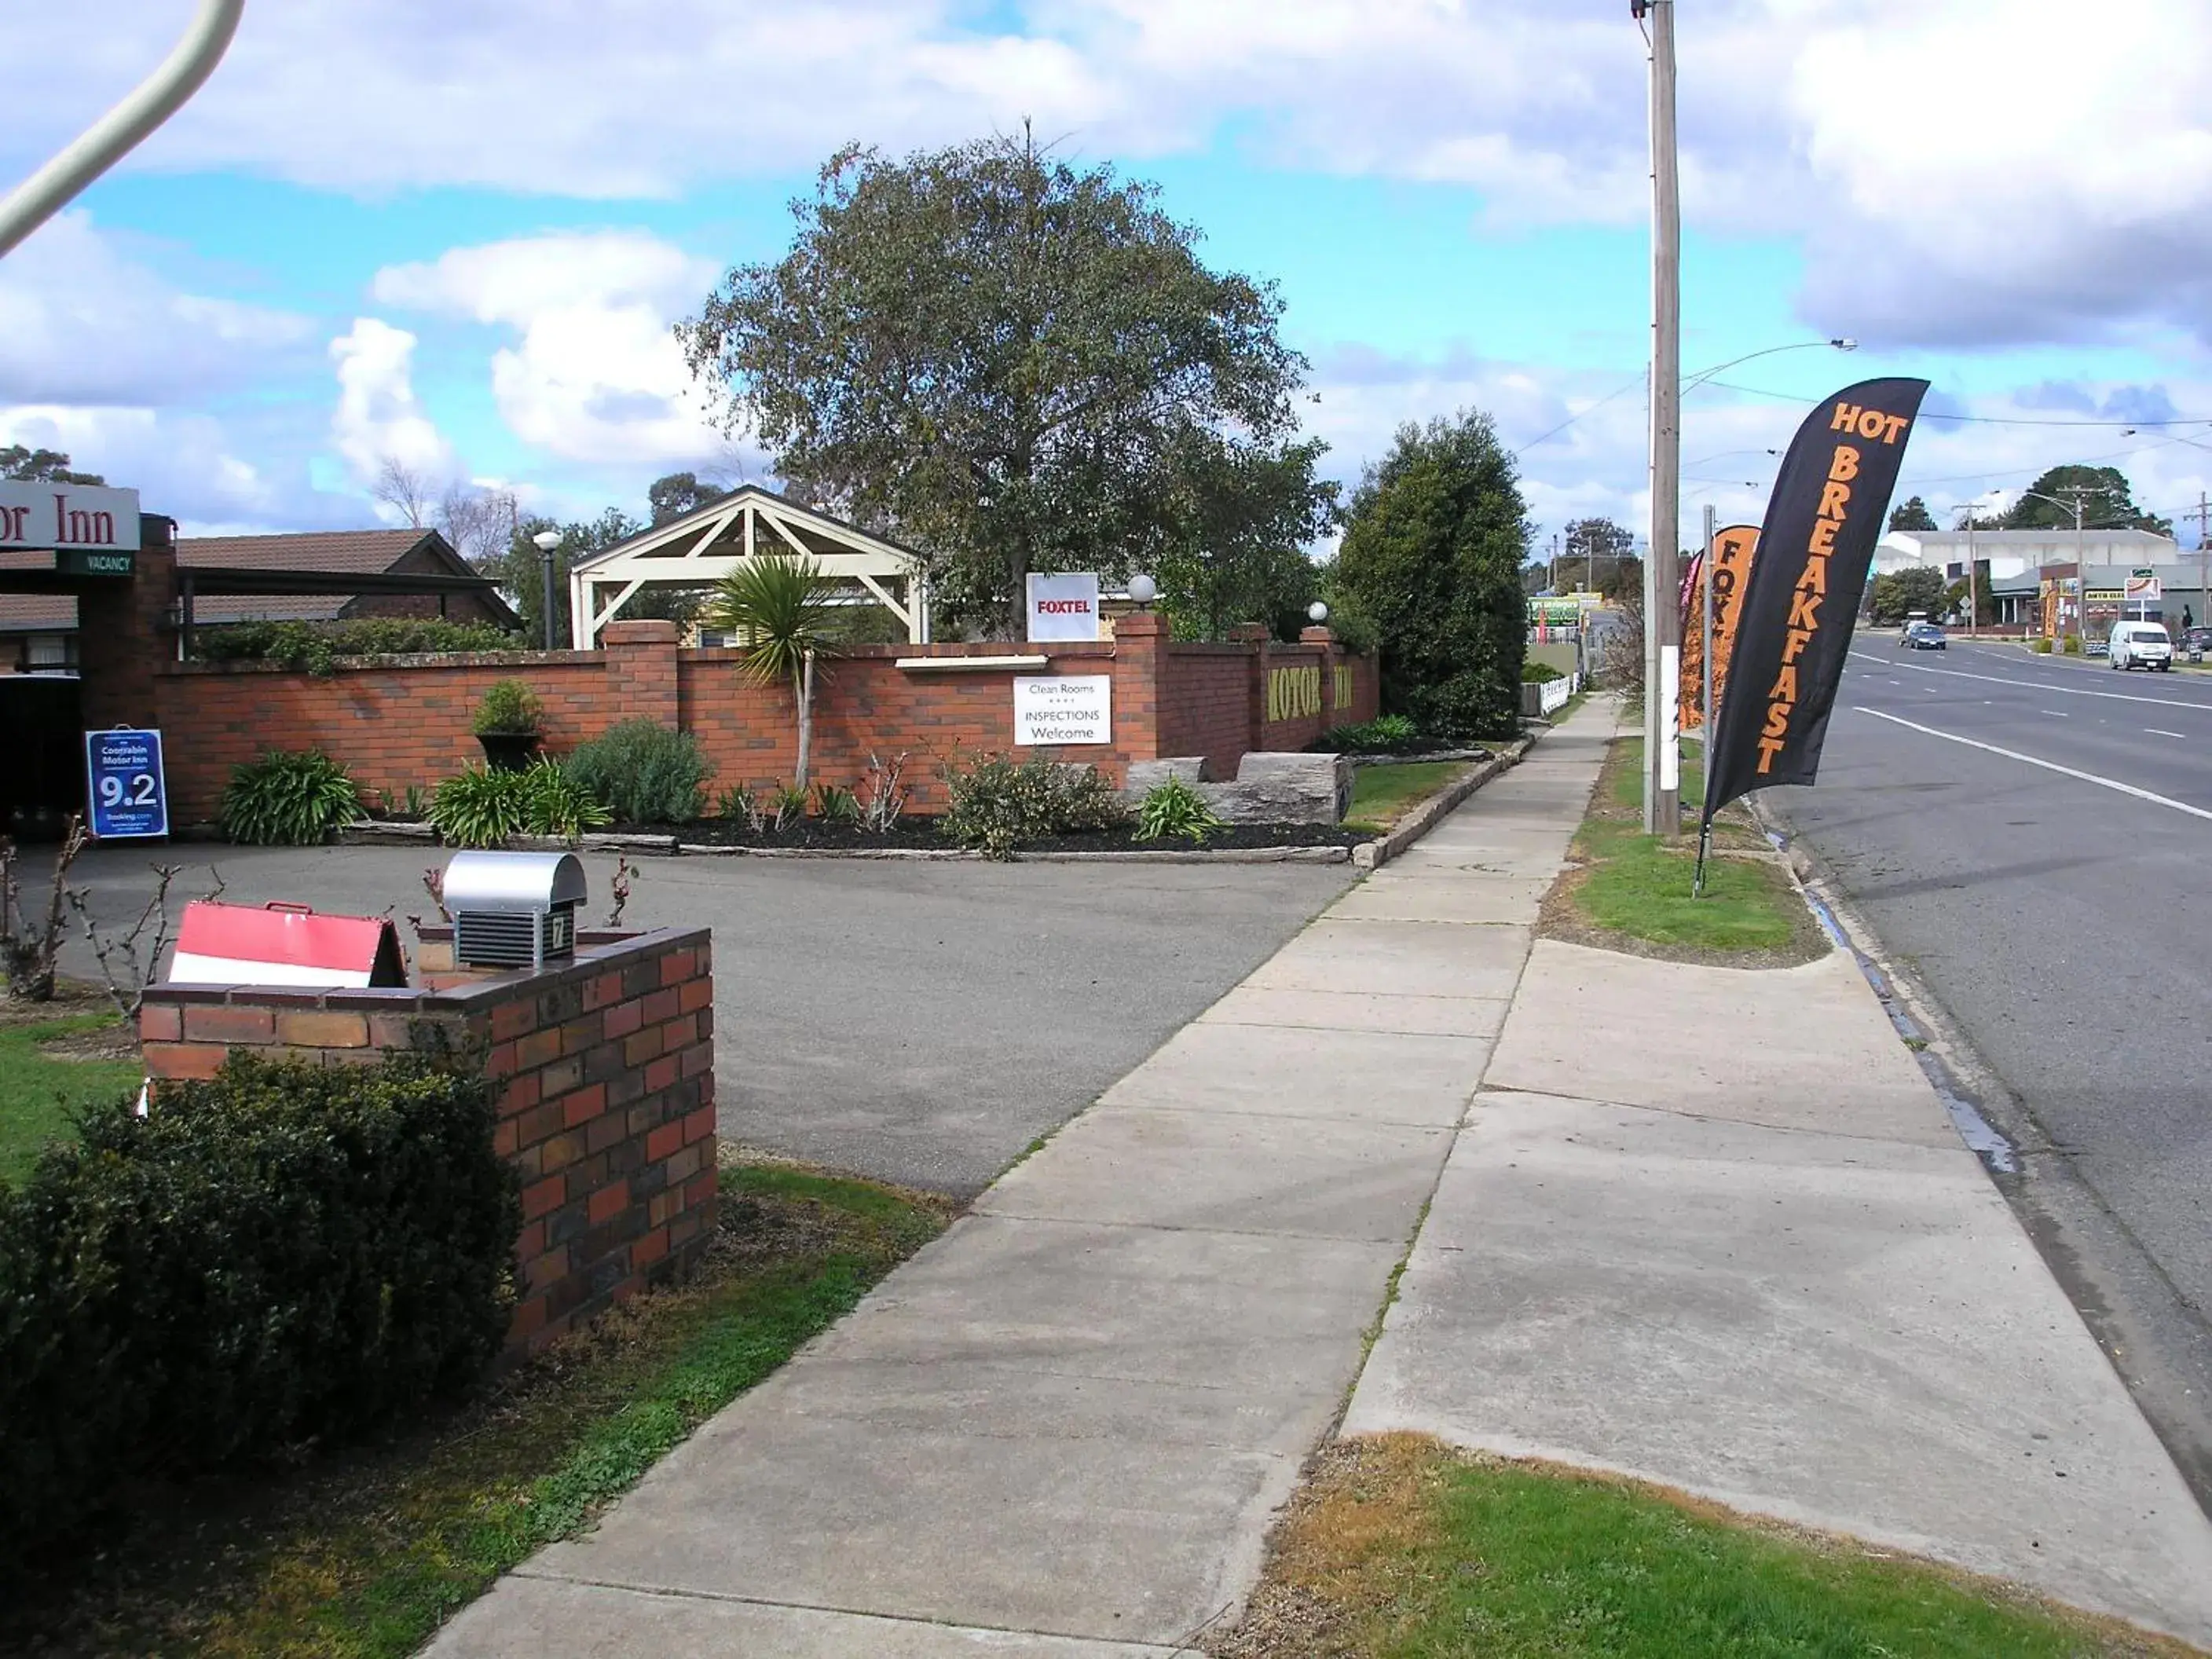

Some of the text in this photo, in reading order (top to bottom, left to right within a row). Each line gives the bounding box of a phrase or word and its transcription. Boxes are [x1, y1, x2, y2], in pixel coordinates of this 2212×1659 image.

[1830, 402, 1909, 444] HOT
[52, 493, 117, 544] Inn
[87, 556, 131, 571] VACANCY
[1038, 600, 1091, 614] FOXTEL
[1756, 445, 1859, 774] BREAKFAST
[1029, 683, 1095, 694] Clean Rooms
[1025, 709, 1100, 722] INSPECTIONS
[1031, 727, 1094, 739] Welcome
[102, 756, 131, 764] Motor
[100, 774, 157, 808] 9.2
